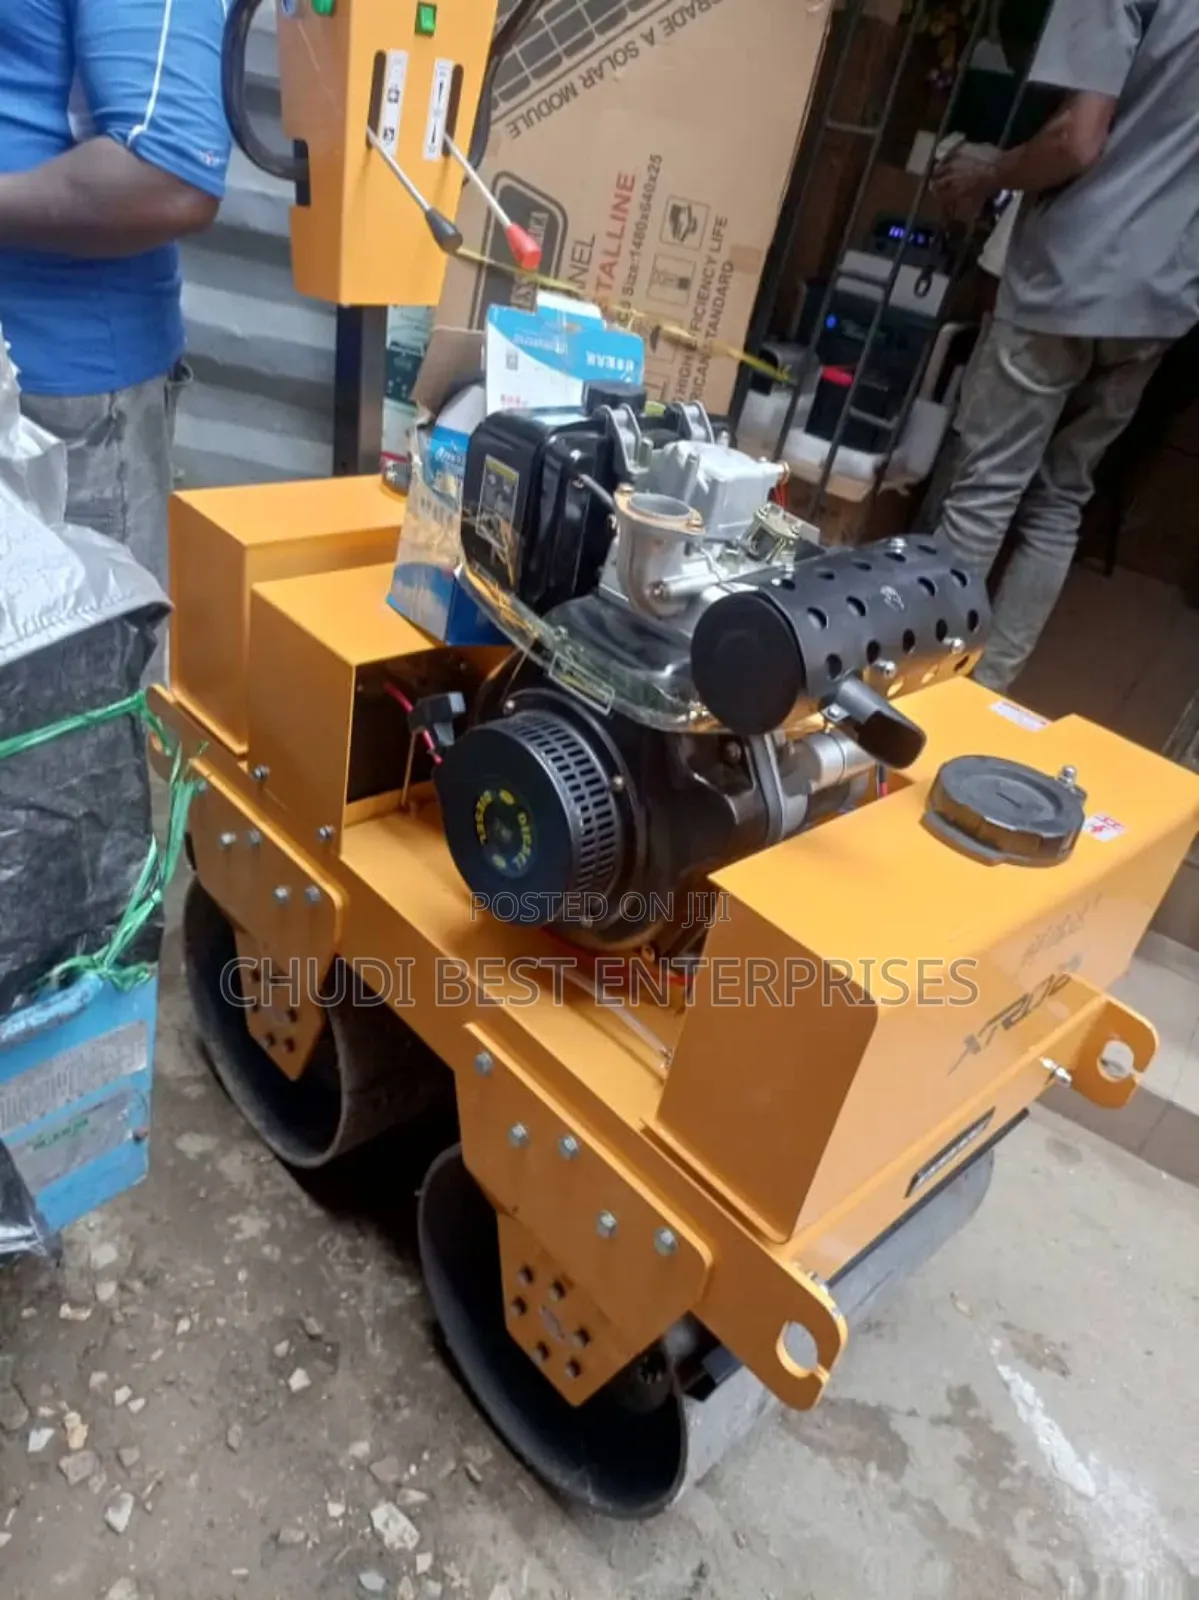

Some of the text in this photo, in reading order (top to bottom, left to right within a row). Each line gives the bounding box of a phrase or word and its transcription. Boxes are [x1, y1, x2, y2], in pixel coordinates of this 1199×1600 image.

[580, 39, 640, 91] SOLAR
[639, 27, 656, 48] A
[504, 80, 579, 140] MODULE
[568, 232, 596, 290] NEL
[595, 170, 636, 305] TALLINE
[709, 214, 728, 253] LIFE
[704, 259, 735, 348] TANDARD
